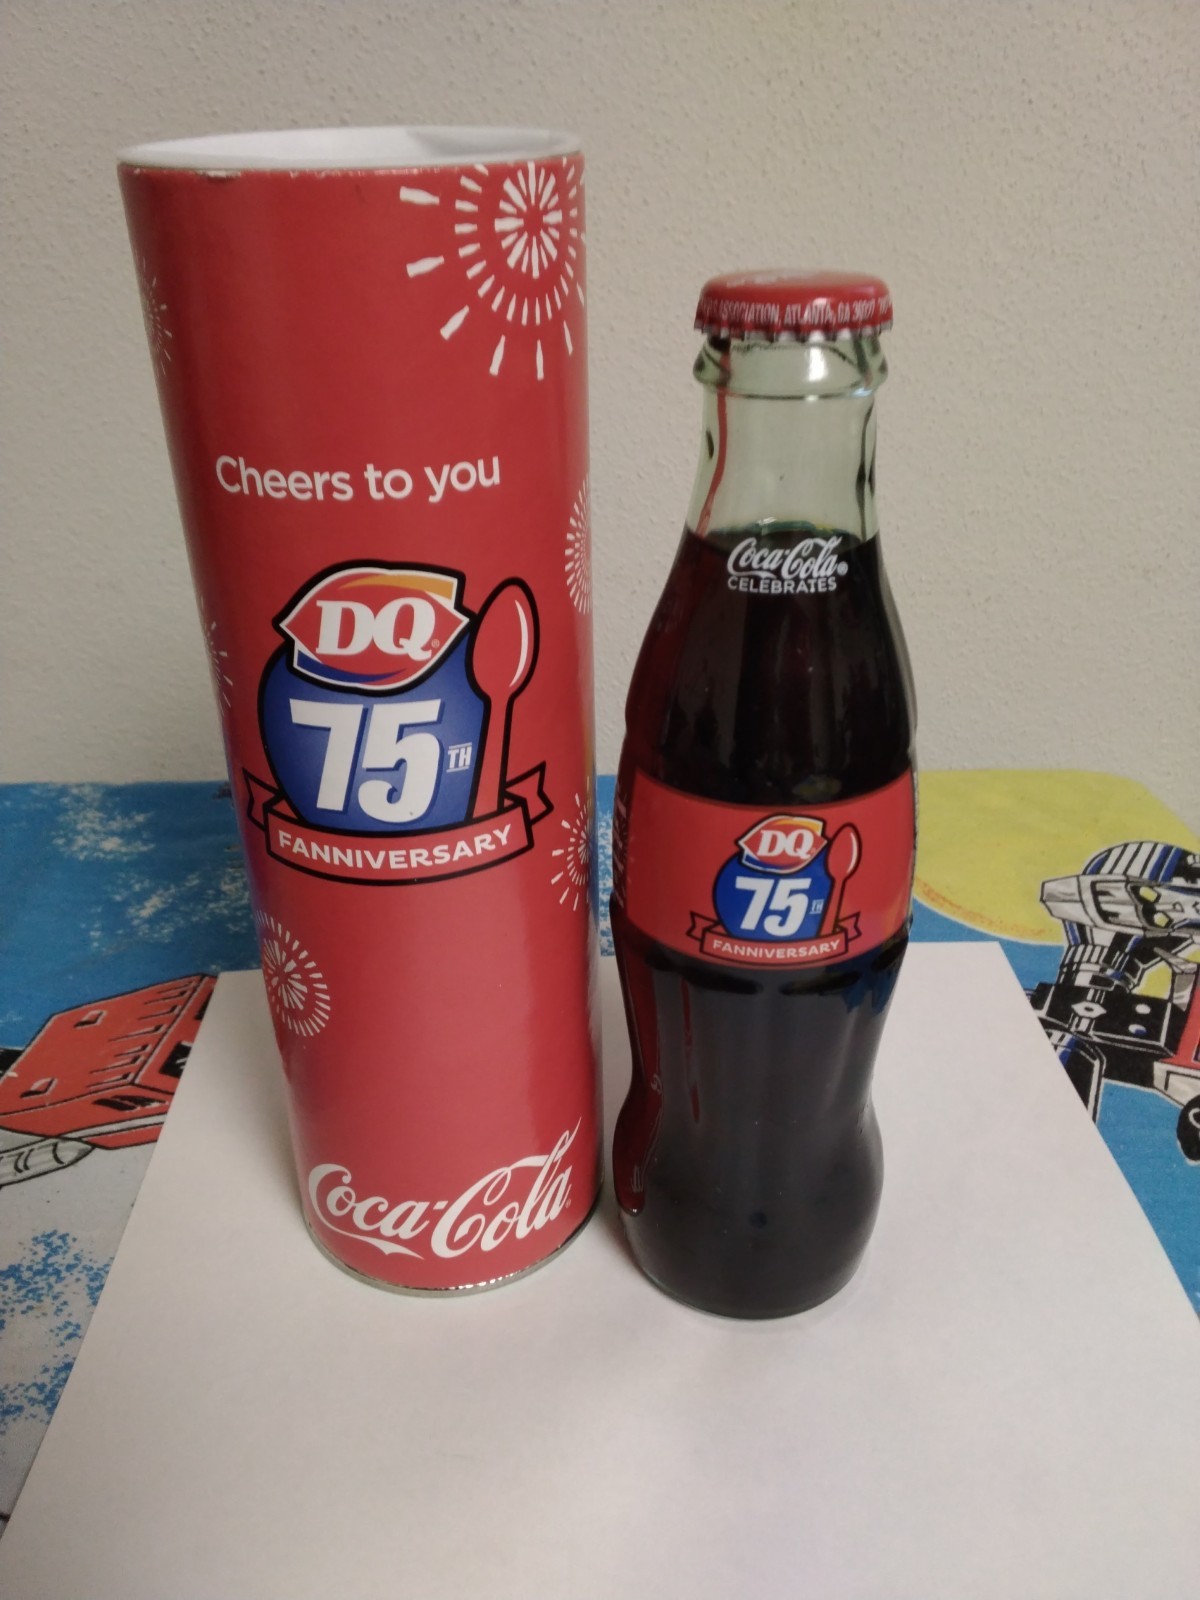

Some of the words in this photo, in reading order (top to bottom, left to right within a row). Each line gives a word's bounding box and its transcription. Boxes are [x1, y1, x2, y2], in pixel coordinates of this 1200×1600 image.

[783, 301, 836, 327] ATLANTA,
[837, 302, 851, 323] GA
[215, 455, 354, 501] Cheers
[364, 463, 413, 500] to
[424, 455, 501, 503] you
[727, 535, 843, 580] Coca-Cola
[727, 575, 837, 595] CELEBRATES
[315, 596, 436, 662] DQ
[278, 823, 512, 870] FANNIVERSARY
[756, 828, 815, 859] DQ
[712, 939, 841, 960] FANNIVERSARY
[308, 1116, 583, 1260] Coca-Cola
